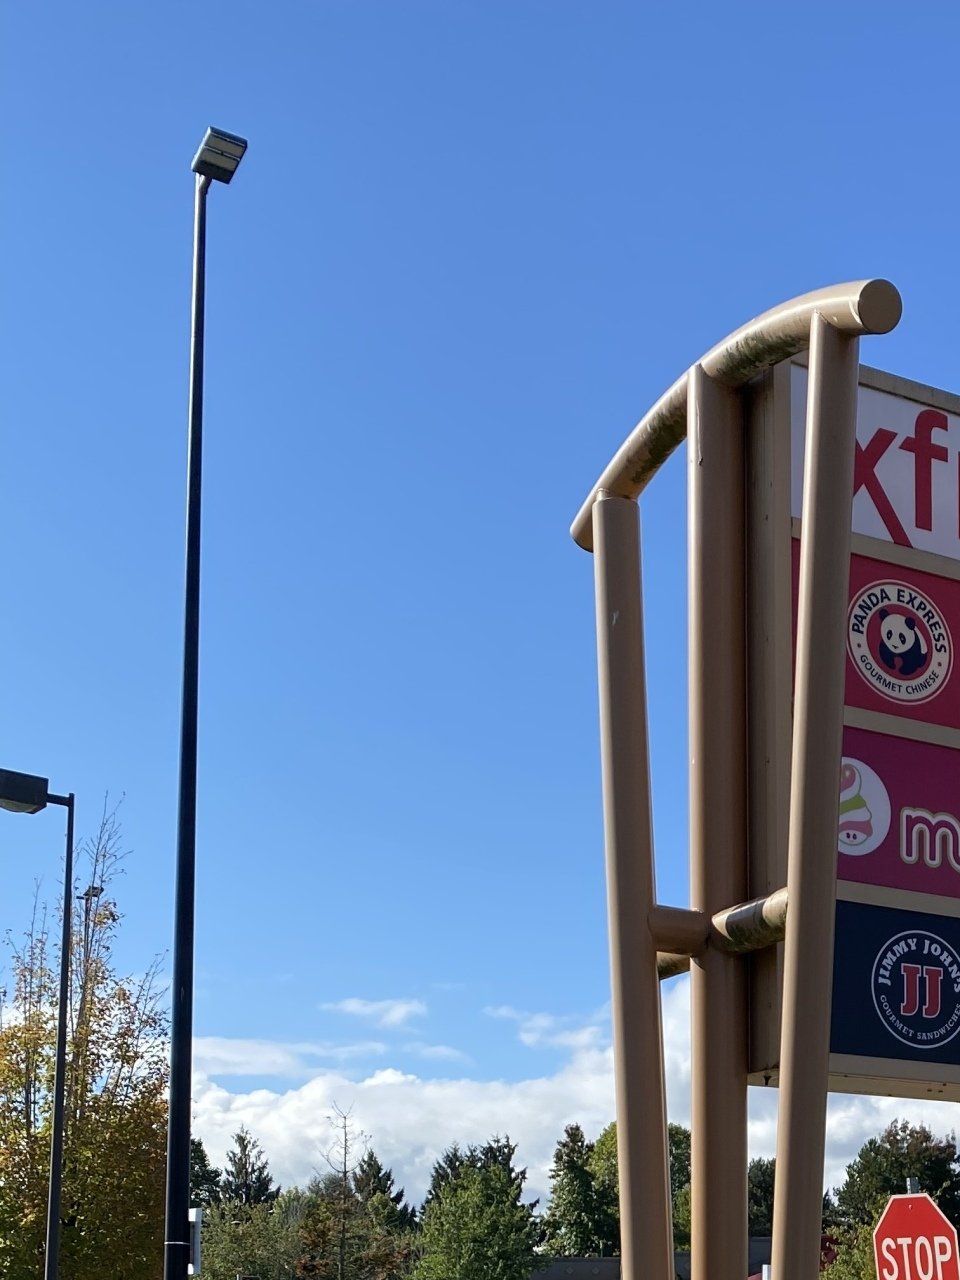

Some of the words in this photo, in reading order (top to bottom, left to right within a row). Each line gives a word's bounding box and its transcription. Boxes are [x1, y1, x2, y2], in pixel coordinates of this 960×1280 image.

[852, 588, 891, 635] PANDA
[896, 588, 947, 654] EXPRESS
[860, 654, 903, 693] GOURMET
[905, 670, 940, 695] CHINESE
[878, 938, 917, 987] JIMMY
[900, 962, 944, 1019] JJ
[880, 994, 915, 1038] GOURMET
